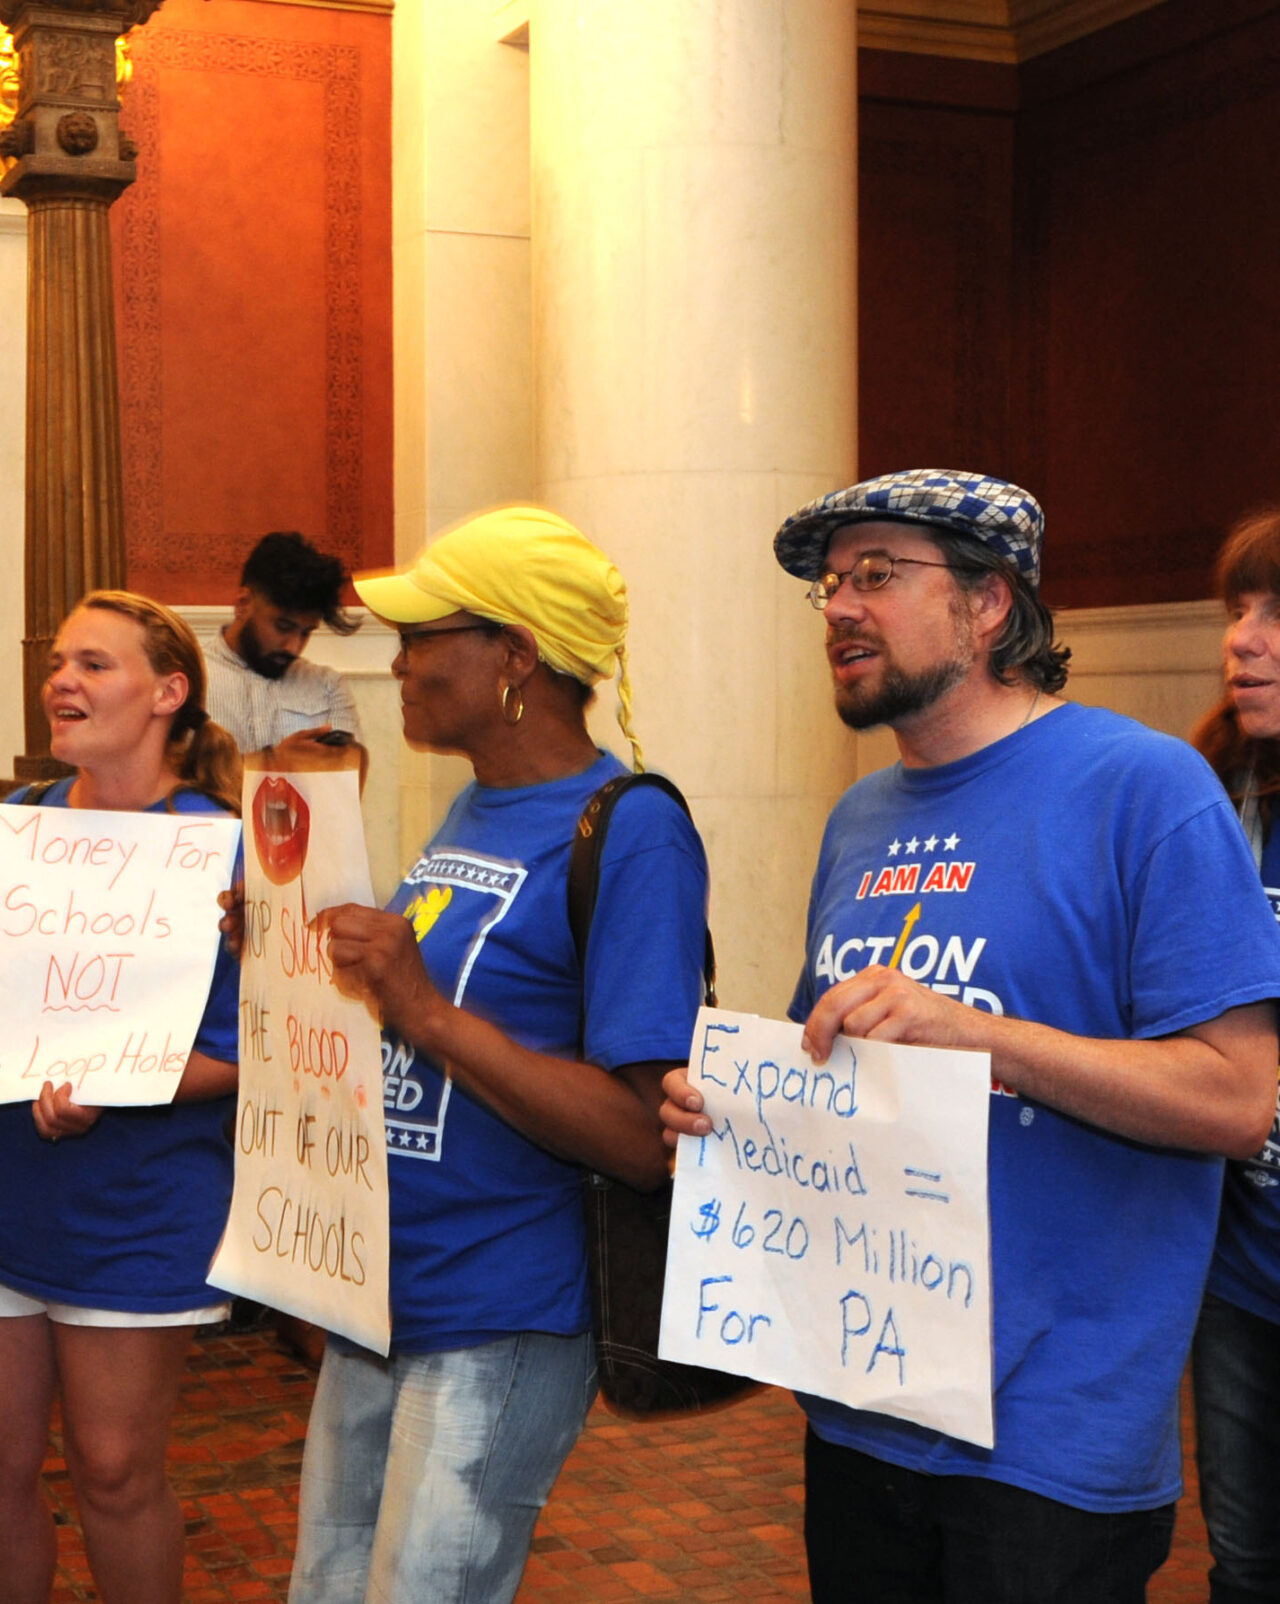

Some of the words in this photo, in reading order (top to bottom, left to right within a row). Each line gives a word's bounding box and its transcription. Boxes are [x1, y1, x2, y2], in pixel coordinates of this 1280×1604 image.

[165, 823, 220, 871] For
[856, 871, 872, 900] I
[870, 863, 921, 898] AM
[920, 862, 976, 893] AN
[3, 884, 171, 939] Schools
[244, 900, 271, 959] TOP
[44, 952, 135, 1004] NOT
[21, 1035, 107, 1090] Loop
[114, 1030, 187, 1074] Holes
[239, 1000, 272, 1062] THE
[287, 1014, 349, 1081] BLOOD
[701, 1025, 858, 1123] Expand
[240, 1100, 283, 1157] OUT
[296, 1112, 316, 1170] OF
[326, 1126, 373, 1191] OUR
[699, 1118, 866, 1196] Medicaid
[253, 1186, 365, 1286] SCHOOLS
[690, 1198, 809, 1259] $620
[834, 1216, 973, 1308] Million
[696, 1275, 771, 1344] For
[840, 1289, 905, 1386] PA
